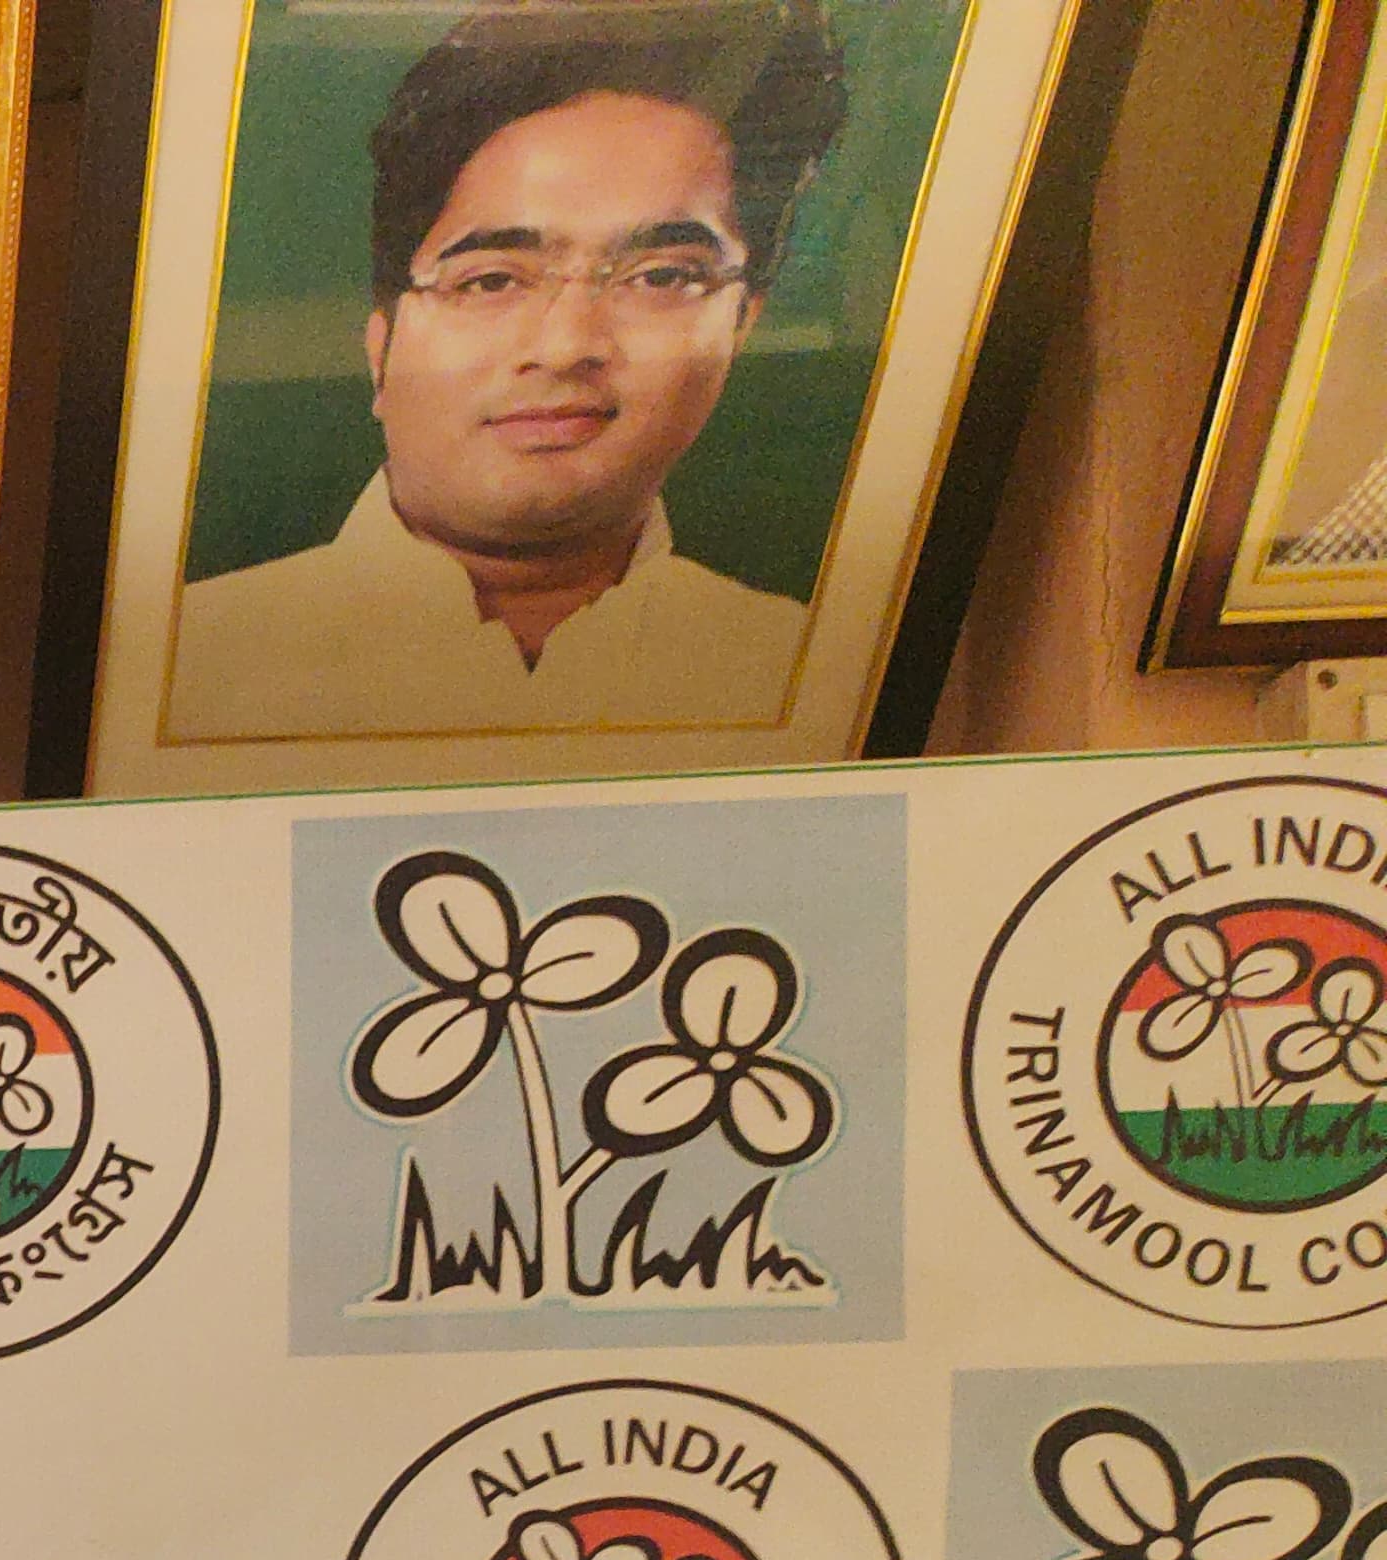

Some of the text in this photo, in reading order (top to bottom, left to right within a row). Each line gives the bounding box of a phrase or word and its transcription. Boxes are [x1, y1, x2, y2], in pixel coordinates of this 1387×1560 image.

[1110, 816, 1387, 923] ALL INDI
[1004, 1006, 1269, 1293] TRINAMOOL
[469, 1418, 779, 1517] ALL INDIA
